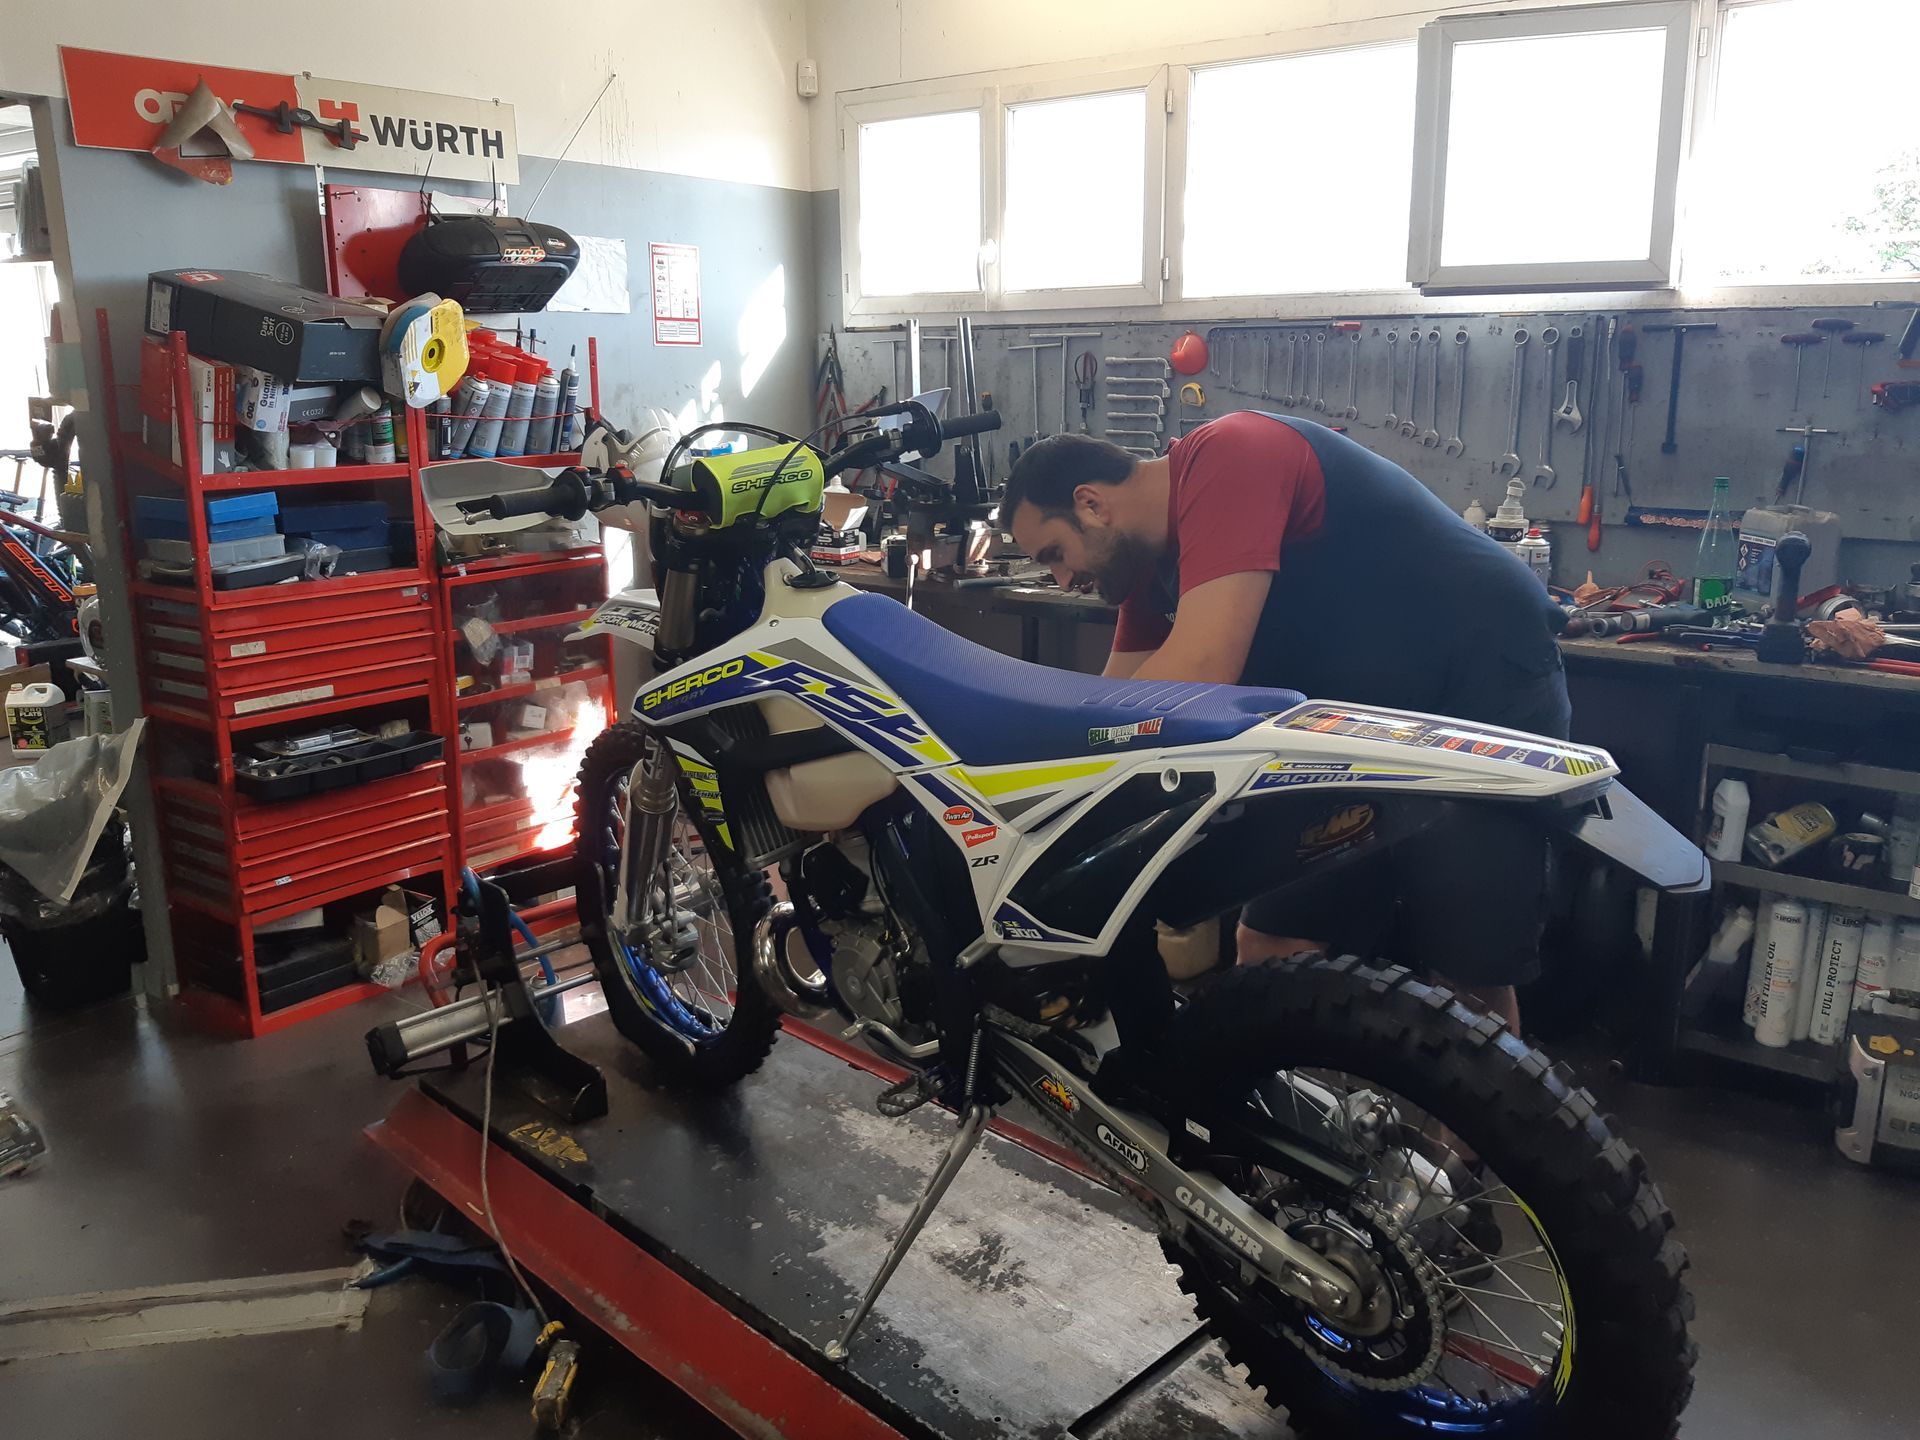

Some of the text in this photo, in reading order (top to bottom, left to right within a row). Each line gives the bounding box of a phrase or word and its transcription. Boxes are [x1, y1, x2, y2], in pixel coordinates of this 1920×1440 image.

[643, 659, 744, 711] SHERCO
[1264, 773, 1366, 783] FACTORY
[944, 812, 960, 820] Twin
[971, 855, 999, 867] ZR
[1760, 941, 1776, 1018] AIR FILTER OIL
[1821, 940, 1842, 1016] FULL PROTECT
[1103, 1131, 1139, 1166] AFAM
[1175, 1186, 1264, 1262] GALFER
